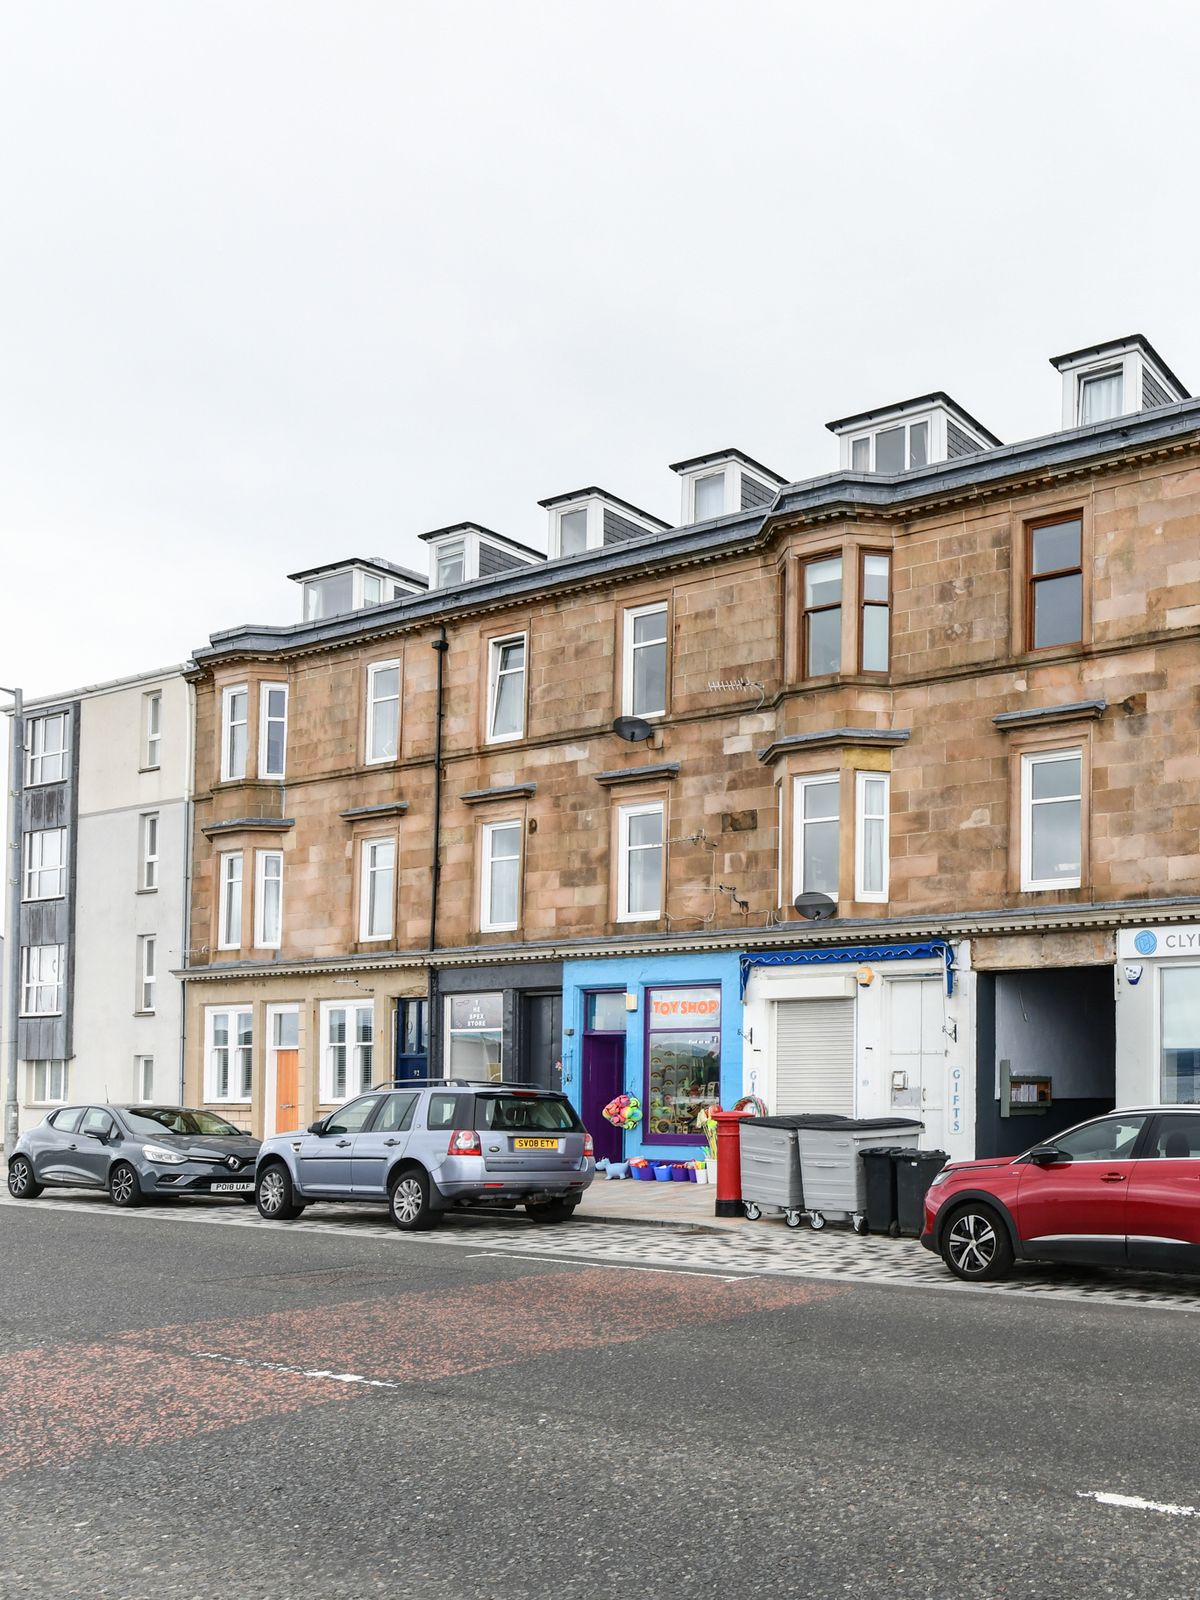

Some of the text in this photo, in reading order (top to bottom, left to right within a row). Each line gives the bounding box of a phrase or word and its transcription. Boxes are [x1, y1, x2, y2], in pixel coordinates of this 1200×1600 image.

[653, 999, 719, 1016] TOY SHOP
[952, 1069, 961, 1131] GIFTS
[518, 1139, 555, 1147] SV08 ETY
